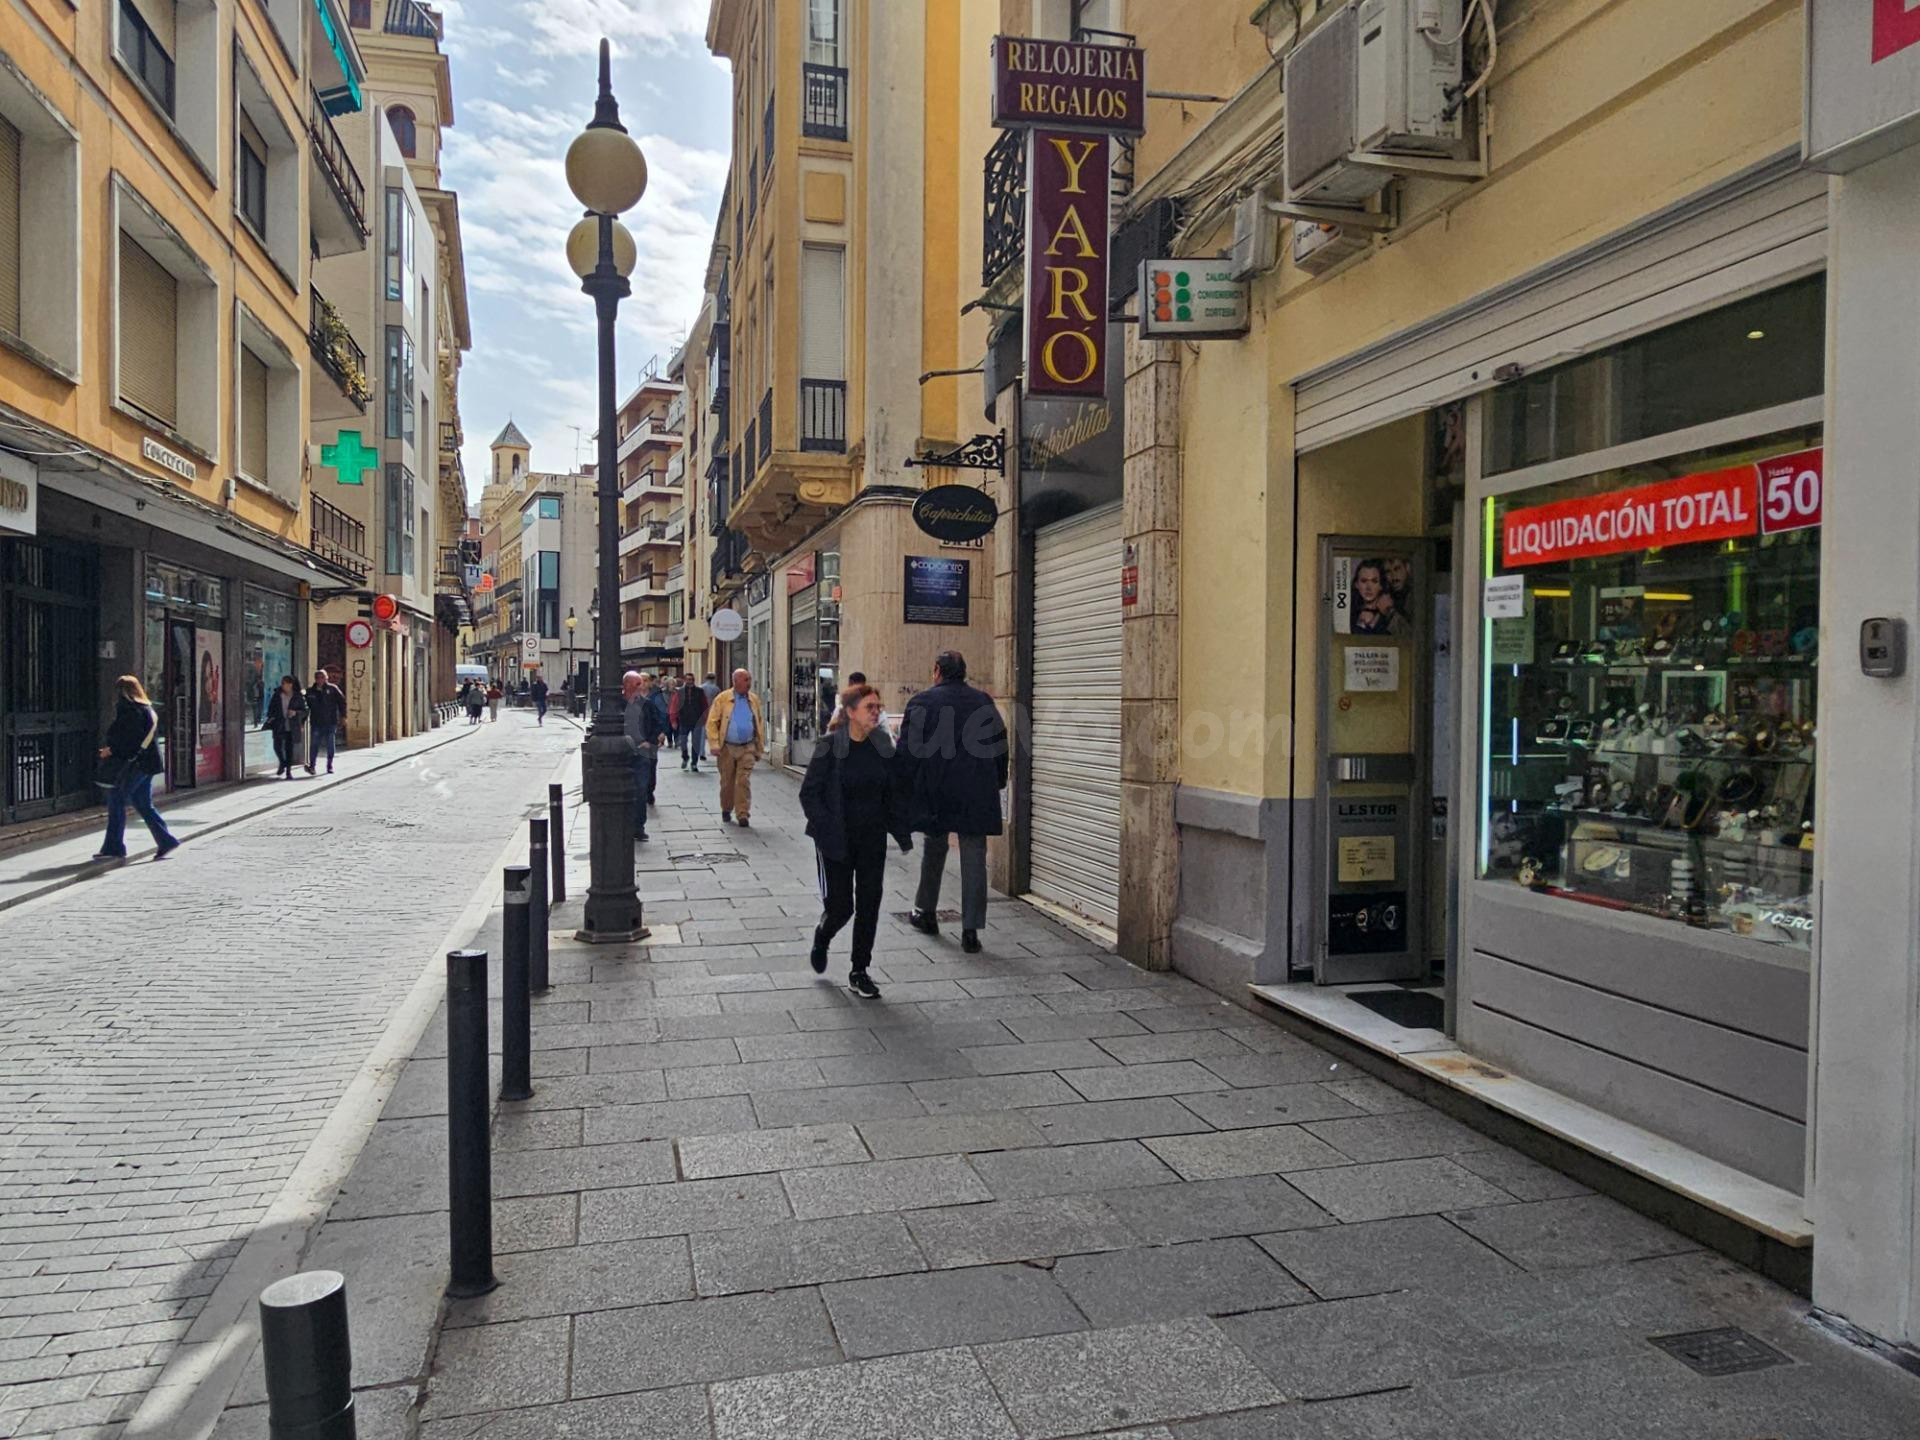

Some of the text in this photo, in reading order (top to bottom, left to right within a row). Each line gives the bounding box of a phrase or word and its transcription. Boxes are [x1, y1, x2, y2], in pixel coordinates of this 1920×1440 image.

[1007, 41, 1139, 81] RELOJERIA
[1020, 83, 1128, 120] REGALOS
[1767, 470, 1820, 521] 50
[1507, 487, 1749, 556] LIQUIDACIÓN TOTAL
